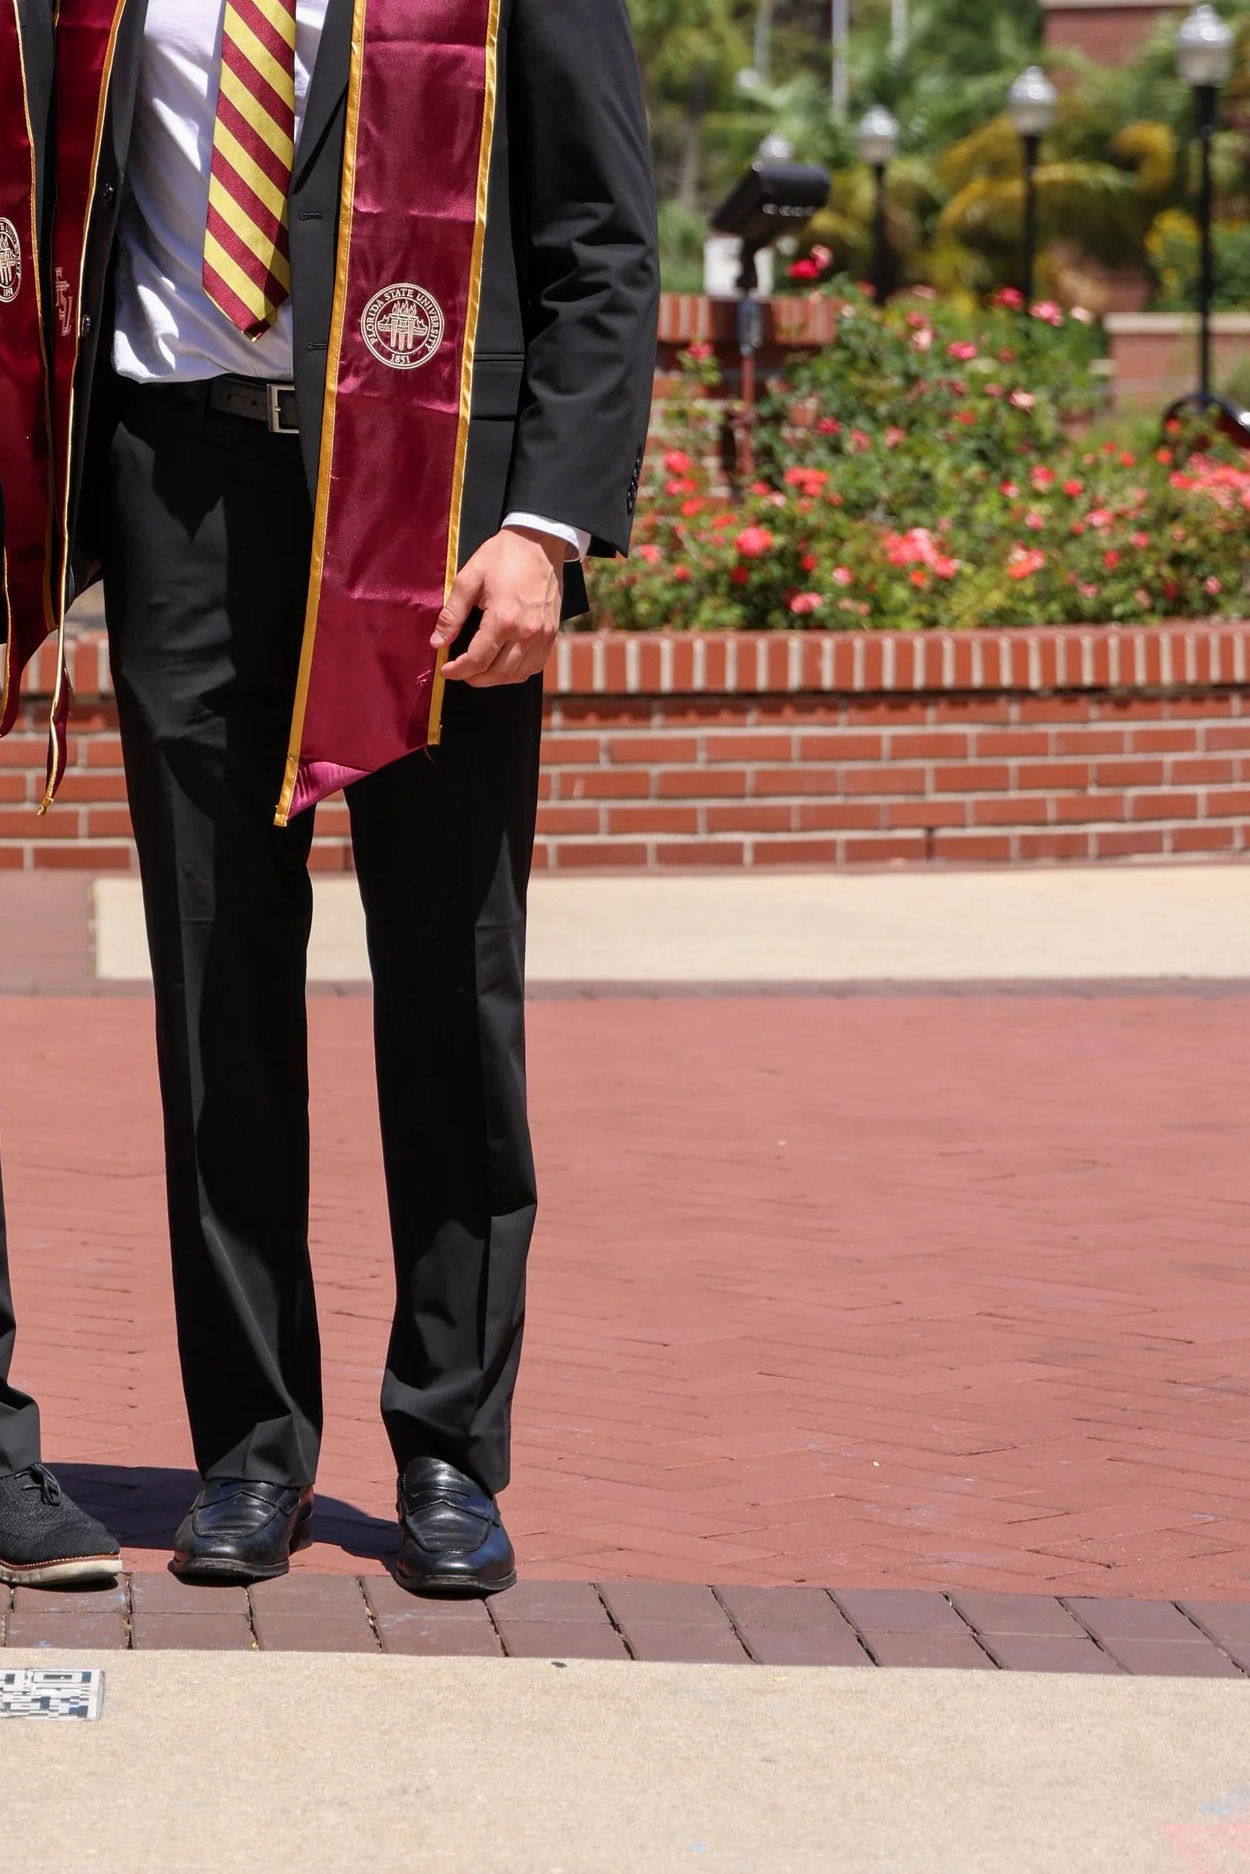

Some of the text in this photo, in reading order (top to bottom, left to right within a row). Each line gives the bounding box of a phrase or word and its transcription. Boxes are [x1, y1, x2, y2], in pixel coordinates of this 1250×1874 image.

[365, 288, 440, 352] FLORIDA STATE UNIVERSITY
[390, 354, 411, 364] 1851
